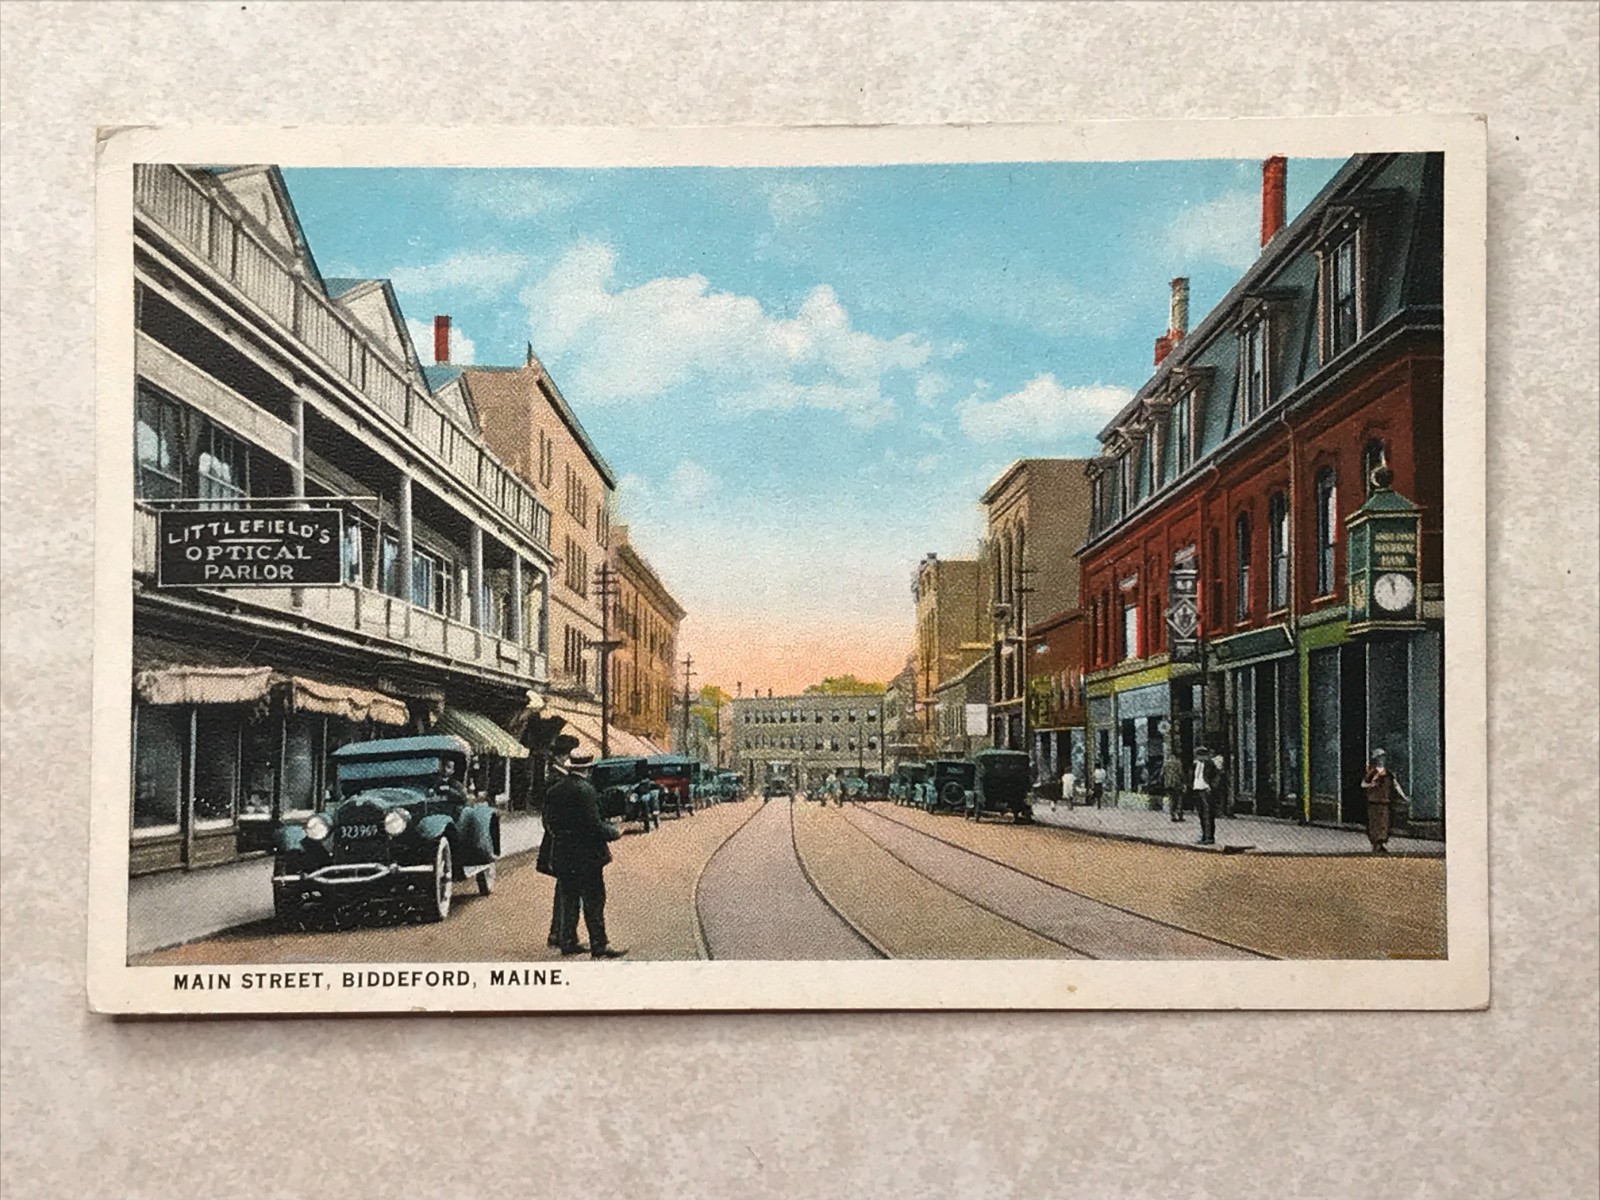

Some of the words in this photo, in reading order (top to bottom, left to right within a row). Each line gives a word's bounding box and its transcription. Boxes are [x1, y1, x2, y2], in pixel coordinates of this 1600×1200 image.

[168, 519, 331, 544] LITTLEFIELD'S
[185, 545, 312, 561] OPTICAL
[204, 564, 294, 581] PARLOR
[173, 974, 231, 990] MAIN
[241, 972, 331, 990] STREET,
[342, 971, 477, 989] BIDDEFORD,
[490, 969, 570, 986] MAINE.
